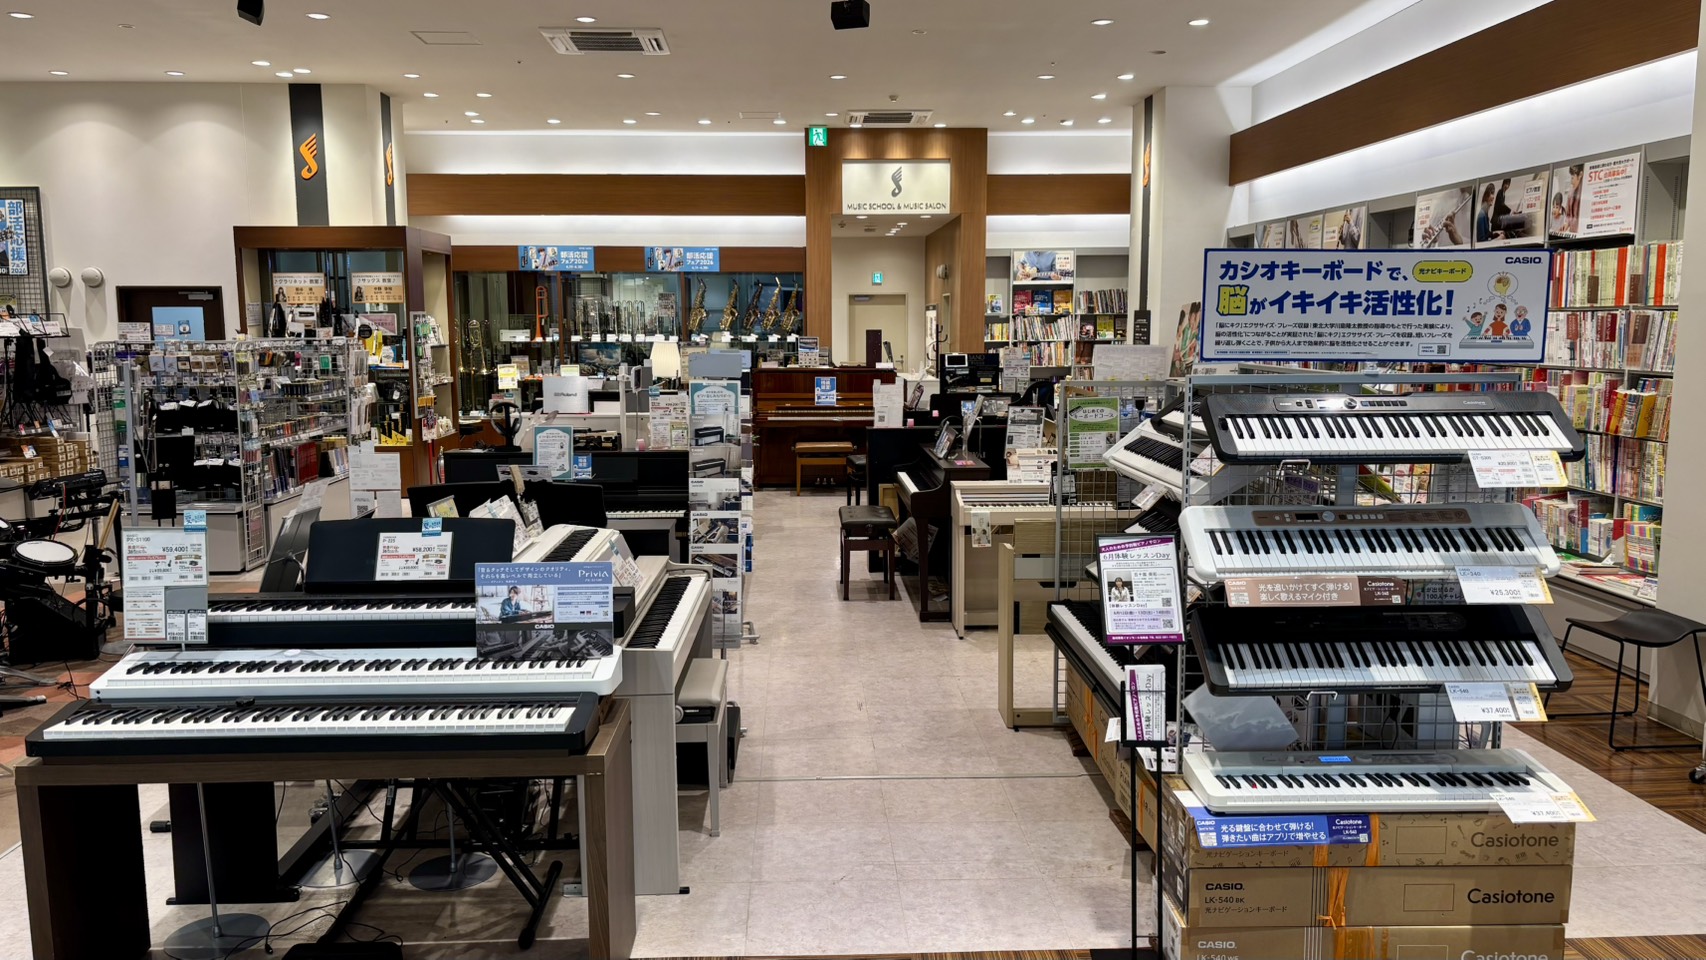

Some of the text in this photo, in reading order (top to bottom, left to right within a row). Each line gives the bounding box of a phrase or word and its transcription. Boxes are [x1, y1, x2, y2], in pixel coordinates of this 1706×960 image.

[1588, 169, 1604, 182] STC
[8, 201, 25, 261] 部活応援
[560, 251, 588, 259] 部活応援
[1505, 256, 1542, 265] CASIO
[1219, 260, 1408, 281] カシオキーボードで、
[1216, 284, 1454, 316] 脳がイキイキ活性化！
[1103, 552, 1171, 560] 6月体験レッスンDay
[579, 569, 609, 578] Privia
[1260, 592, 1339, 601] 楽しく歌えるマイク付き
[1221, 831, 1327, 843] 弾きたい曲はアプリで増やせる
[1471, 832, 1559, 848] Casiotone
[1206, 850, 1289, 858] 光ナビゲーションキーボード
[1205, 882, 1244, 891] CASIO
[1205, 896, 1235, 904] LK-540
[1467, 888, 1555, 904] Casiotone
[1205, 905, 1288, 914] 光ナビゲーションキーボード
[1197, 941, 1237, 949] CASIO
[1461, 950, 1549, 960] Casiotone
